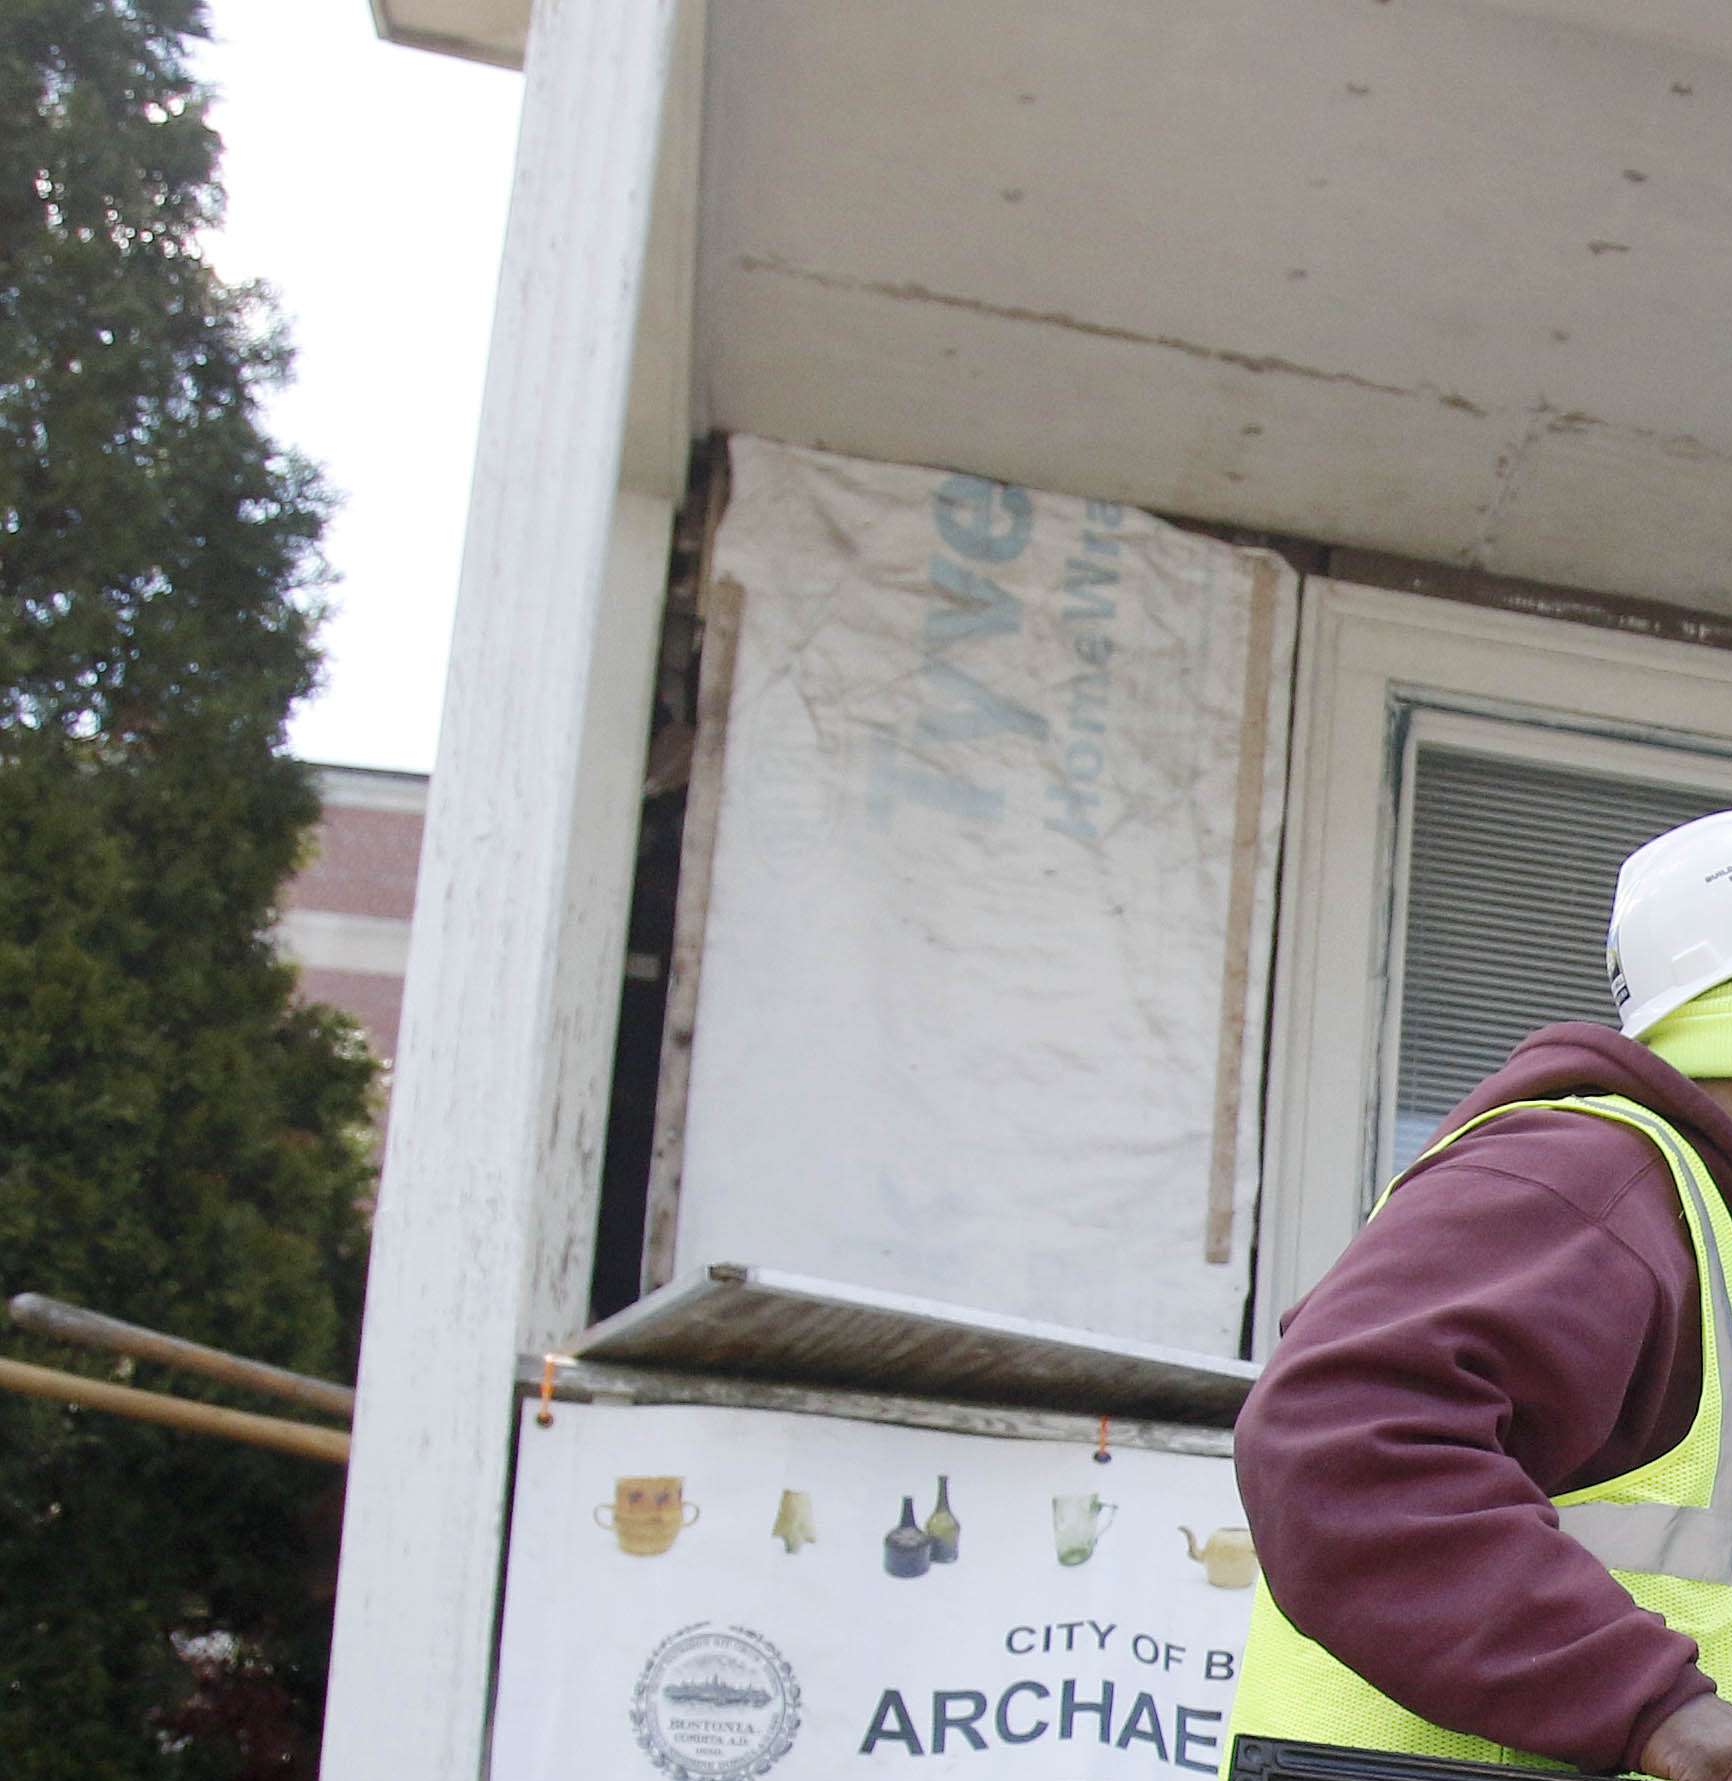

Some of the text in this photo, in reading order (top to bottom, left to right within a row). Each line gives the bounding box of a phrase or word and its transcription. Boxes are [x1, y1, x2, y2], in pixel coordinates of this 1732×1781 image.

[1006, 1620, 1117, 1654] CITY
[1131, 1633, 1186, 1672] OF
[859, 1678, 1222, 1775] ARCHAE
